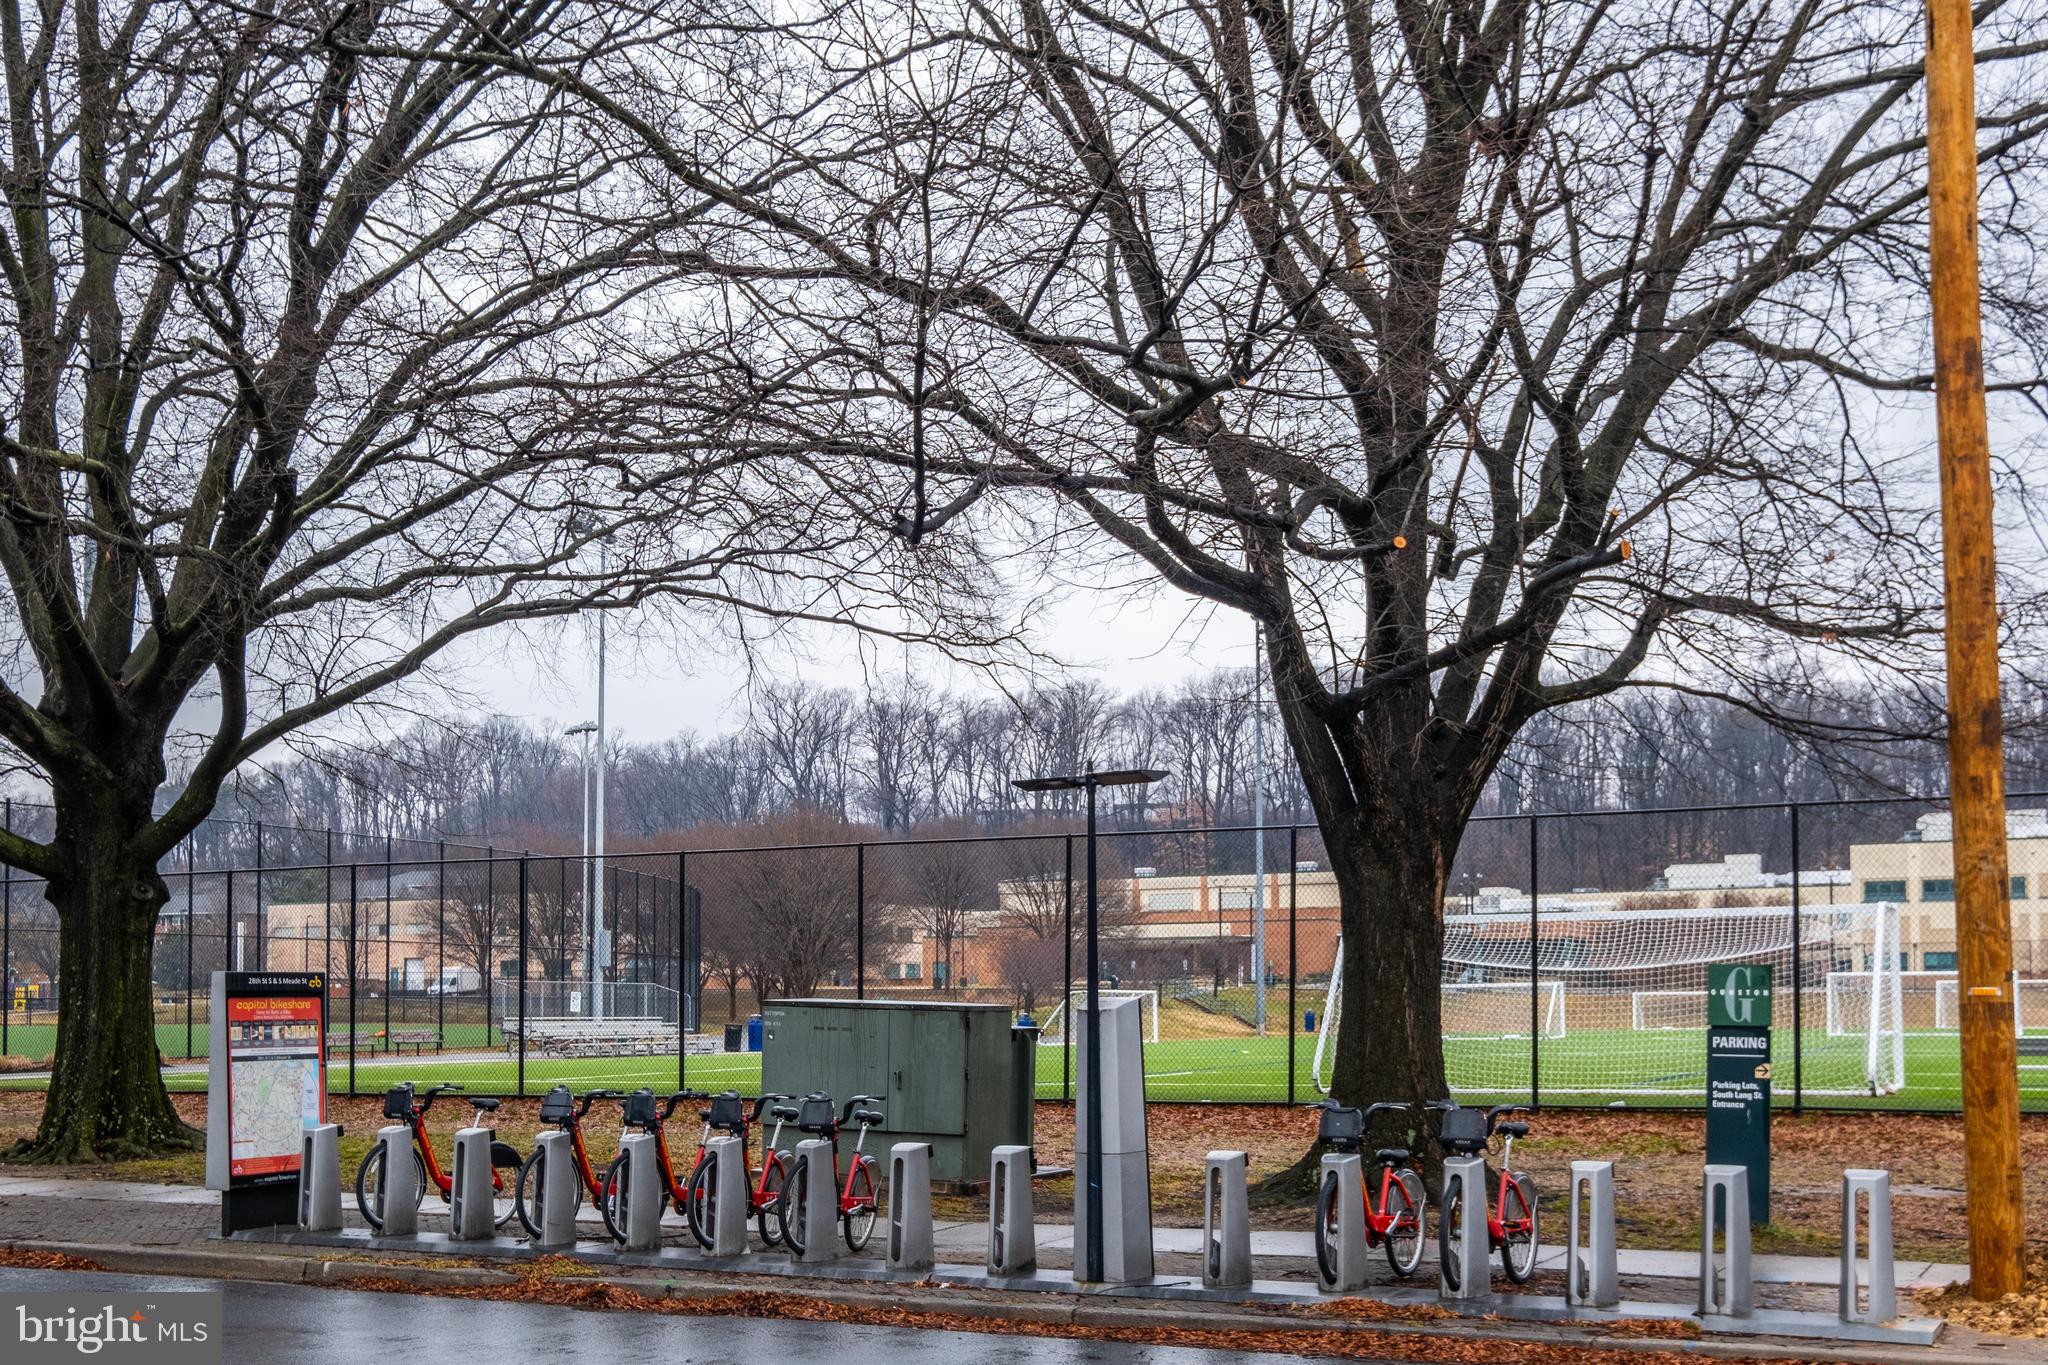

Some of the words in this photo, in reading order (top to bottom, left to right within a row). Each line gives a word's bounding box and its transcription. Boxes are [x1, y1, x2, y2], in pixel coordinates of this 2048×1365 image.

[248, 977, 261, 985] 28th
[262, 977, 268, 985] St
[268, 977, 272, 985] S
[273, 977, 278, 985] &
[278, 977, 282, 985] S
[282, 977, 301, 985] Meade
[301, 977, 307, 985] St
[236, 1000, 268, 1012] capital
[270, 998, 311, 1010] bikeshare
[1712, 1036, 1767, 1049] PARKING
[1712, 1081, 1741, 1091] Parking
[1712, 1090, 1734, 1099] South
[1735, 1091, 1753, 1100] Lang
[1712, 1100, 1745, 1109] Entrance
